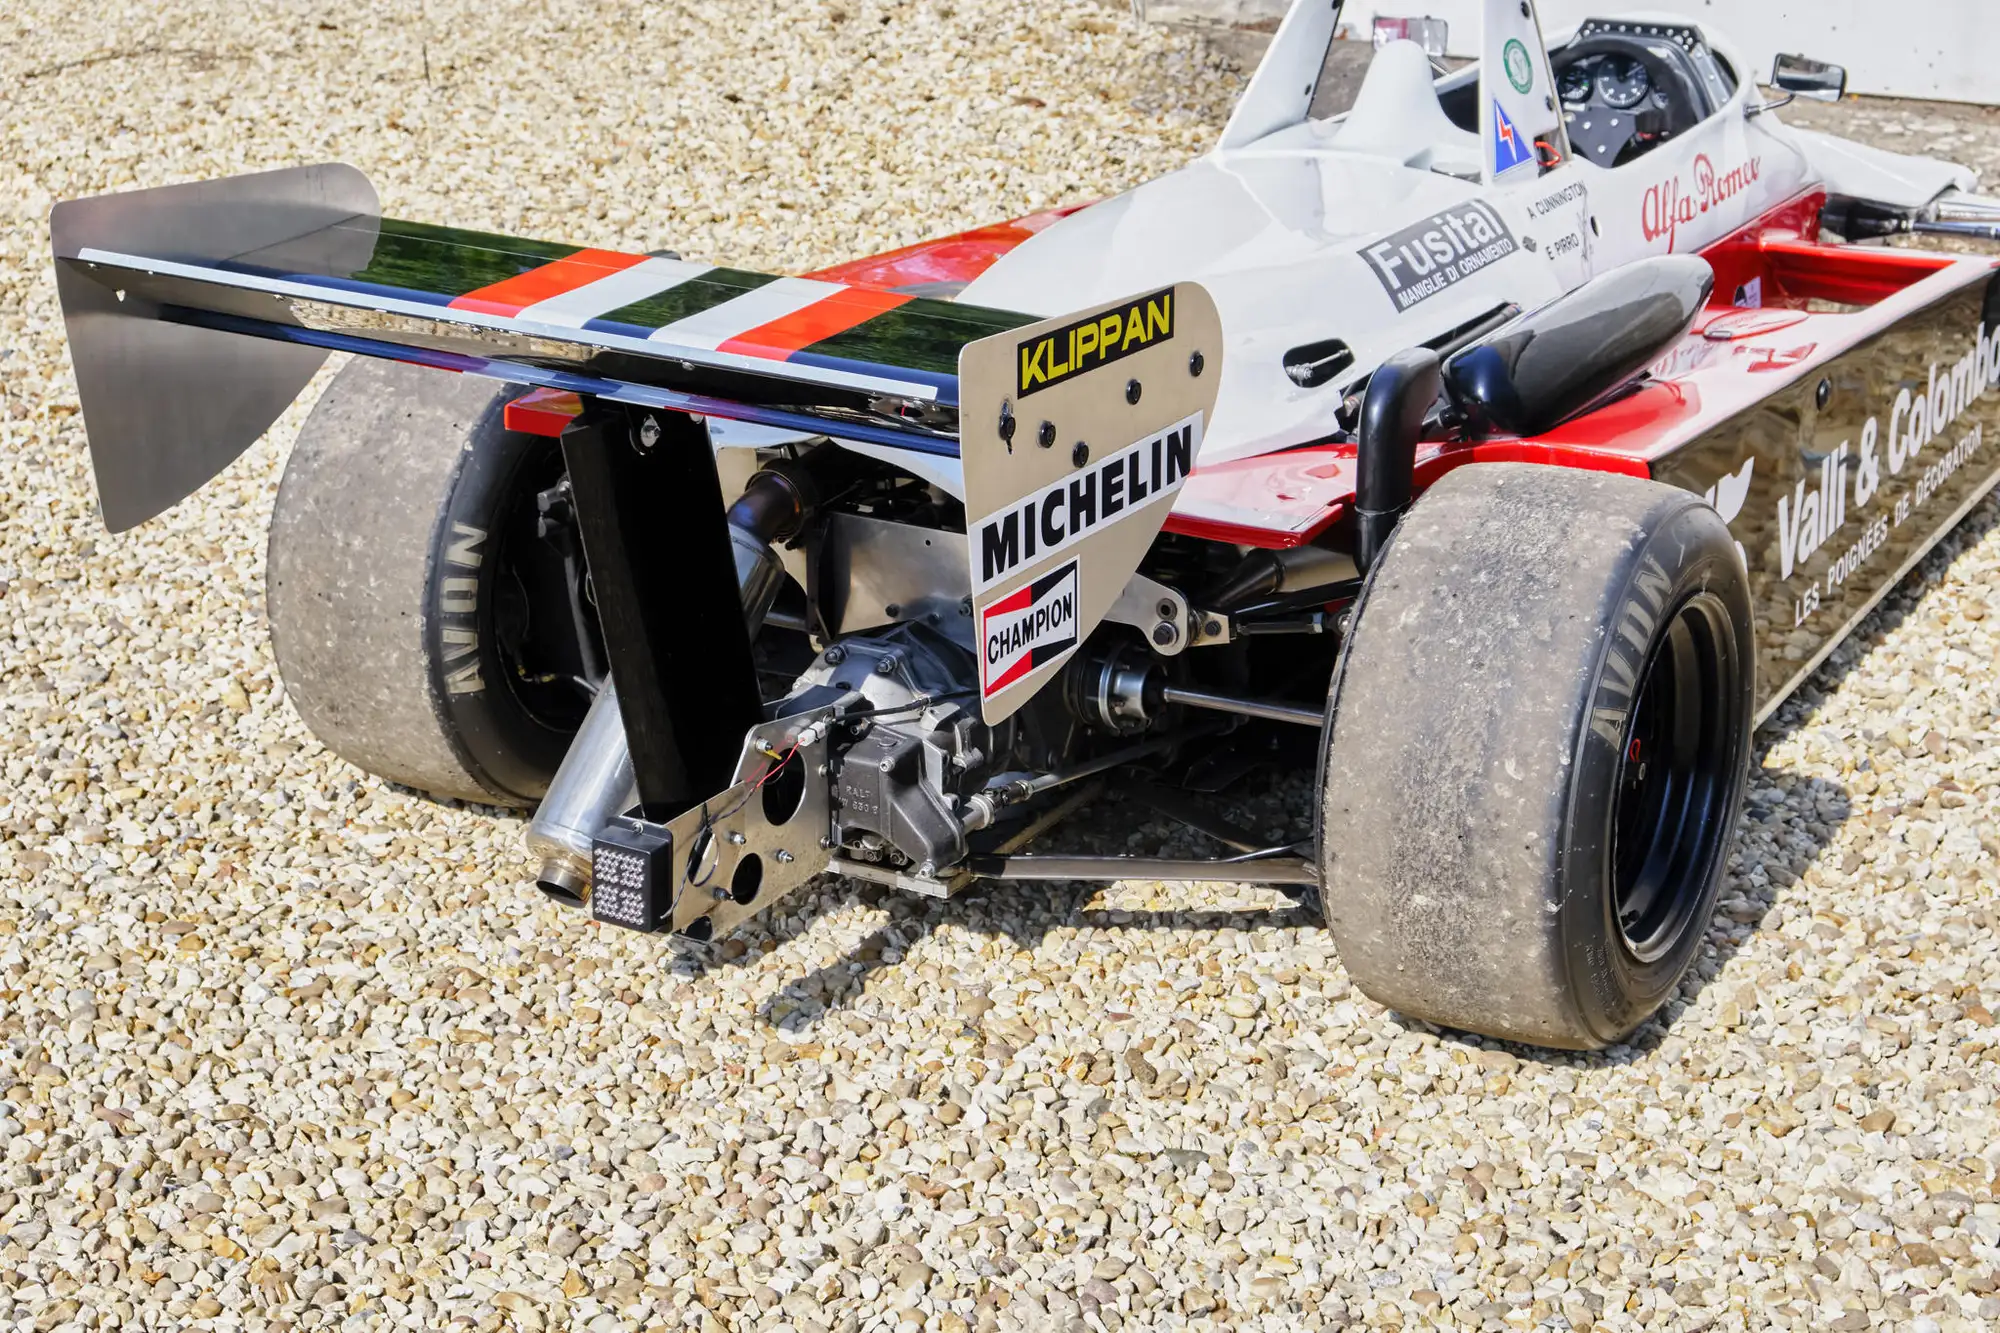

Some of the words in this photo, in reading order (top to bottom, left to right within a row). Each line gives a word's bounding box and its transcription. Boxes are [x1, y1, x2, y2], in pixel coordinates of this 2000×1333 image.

[1367, 200, 1504, 290] Fusital
[1527, 206, 1537, 220] A
[1535, 180, 1587, 215] CUNNINGTON
[1545, 245, 1555, 260] E
[1554, 232, 1579, 256] PIRRO
[1642, 175, 1697, 254] Alfa
[1693, 152, 1760, 212] Romeo
[1397, 272, 1448, 308] MANIGLIE
[1448, 265, 1460, 281] DI
[1461, 238, 1513, 275] ORNAMENTO
[1021, 294, 1171, 390] KLIPPAN
[1777, 440, 1848, 581] Valli
[1855, 416, 1879, 507] &
[1888, 321, 2000, 475] Colombo
[982, 424, 1192, 582] MICHELIN
[1795, 581, 1820, 628] LES
[1827, 514, 1888, 595] POIGNÉES
[1894, 491, 1910, 527] DE
[1915, 422, 1983, 506] DÉCORATION
[441, 520, 488, 694] AVON
[988, 592, 1073, 665] CHAMPION
[1590, 555, 1673, 751] AVON
